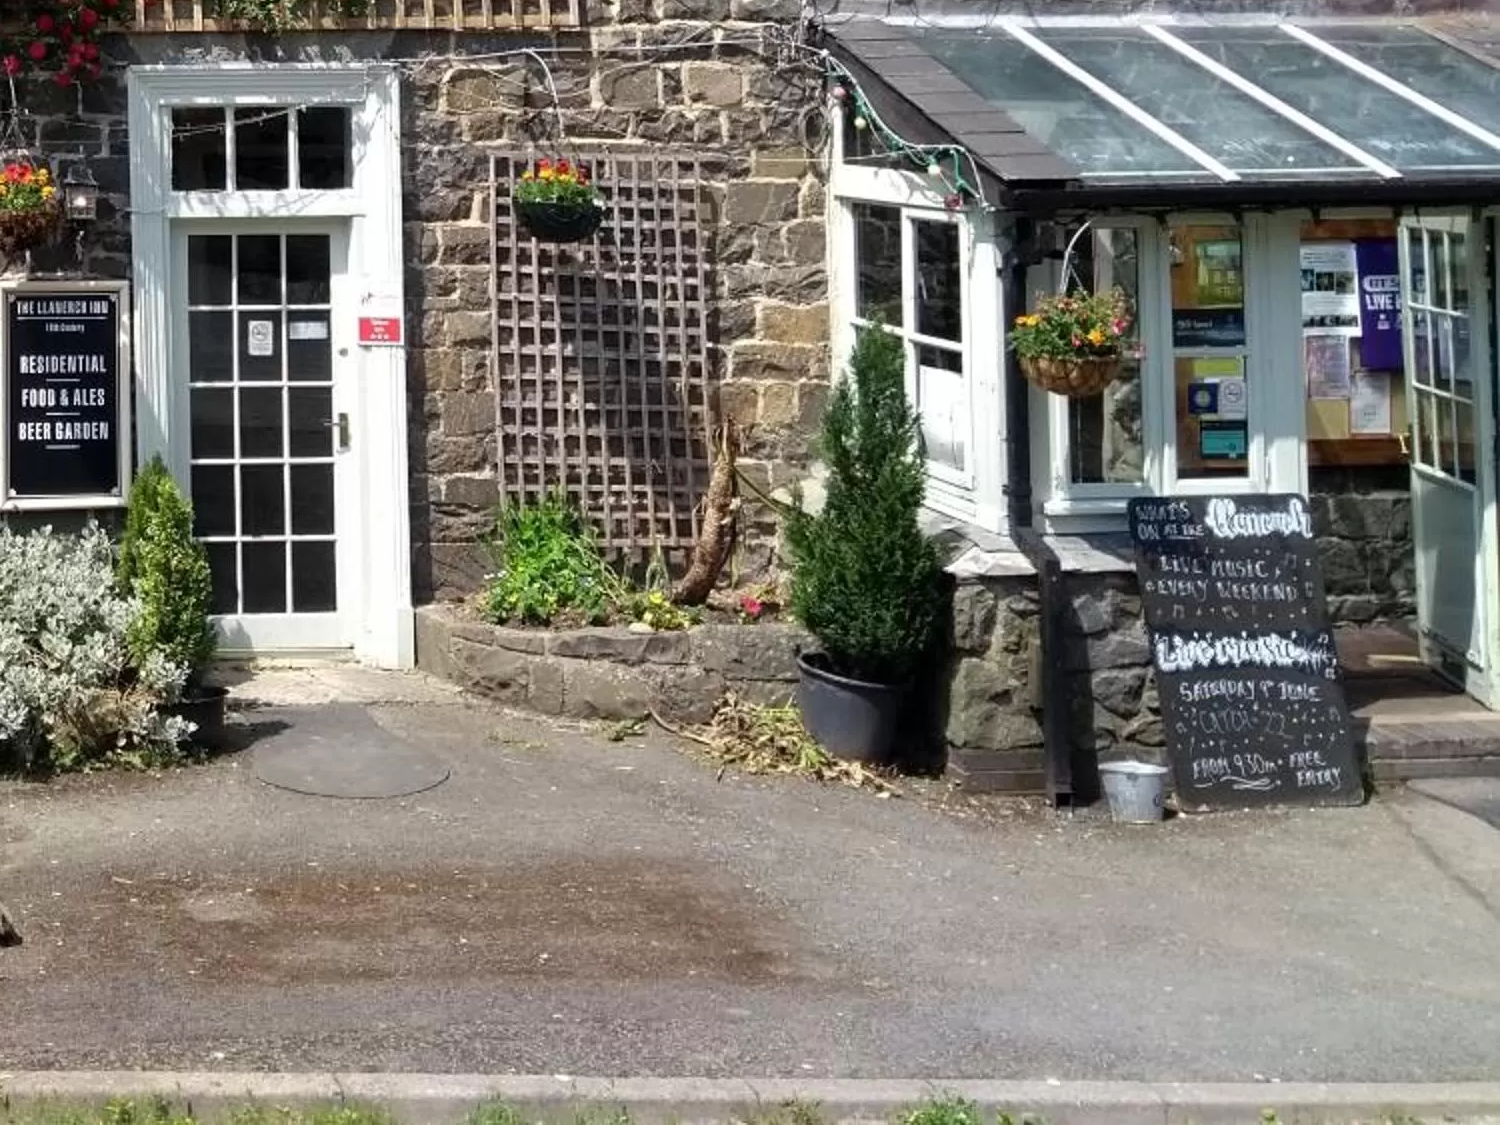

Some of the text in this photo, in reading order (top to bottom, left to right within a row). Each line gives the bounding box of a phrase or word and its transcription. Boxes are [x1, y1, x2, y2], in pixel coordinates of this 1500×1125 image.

[1365, 293, 1393, 310] LIVE
[19, 354, 107, 374] RESIDENTIAL
[21, 388, 105, 408] FOOD & ALES
[18, 421, 109, 441] BEER GARDEN
[1211, 558, 1269, 578] MUSIC
[1158, 579, 1299, 602] EVERY WEEKEND
[1179, 679, 1256, 701] SATURDAY
[1277, 681, 1321, 701] JUNE
[1193, 755, 1230, 779] FROM
[1289, 751, 1326, 767] FREE
[1296, 767, 1341, 790] ENTRY
